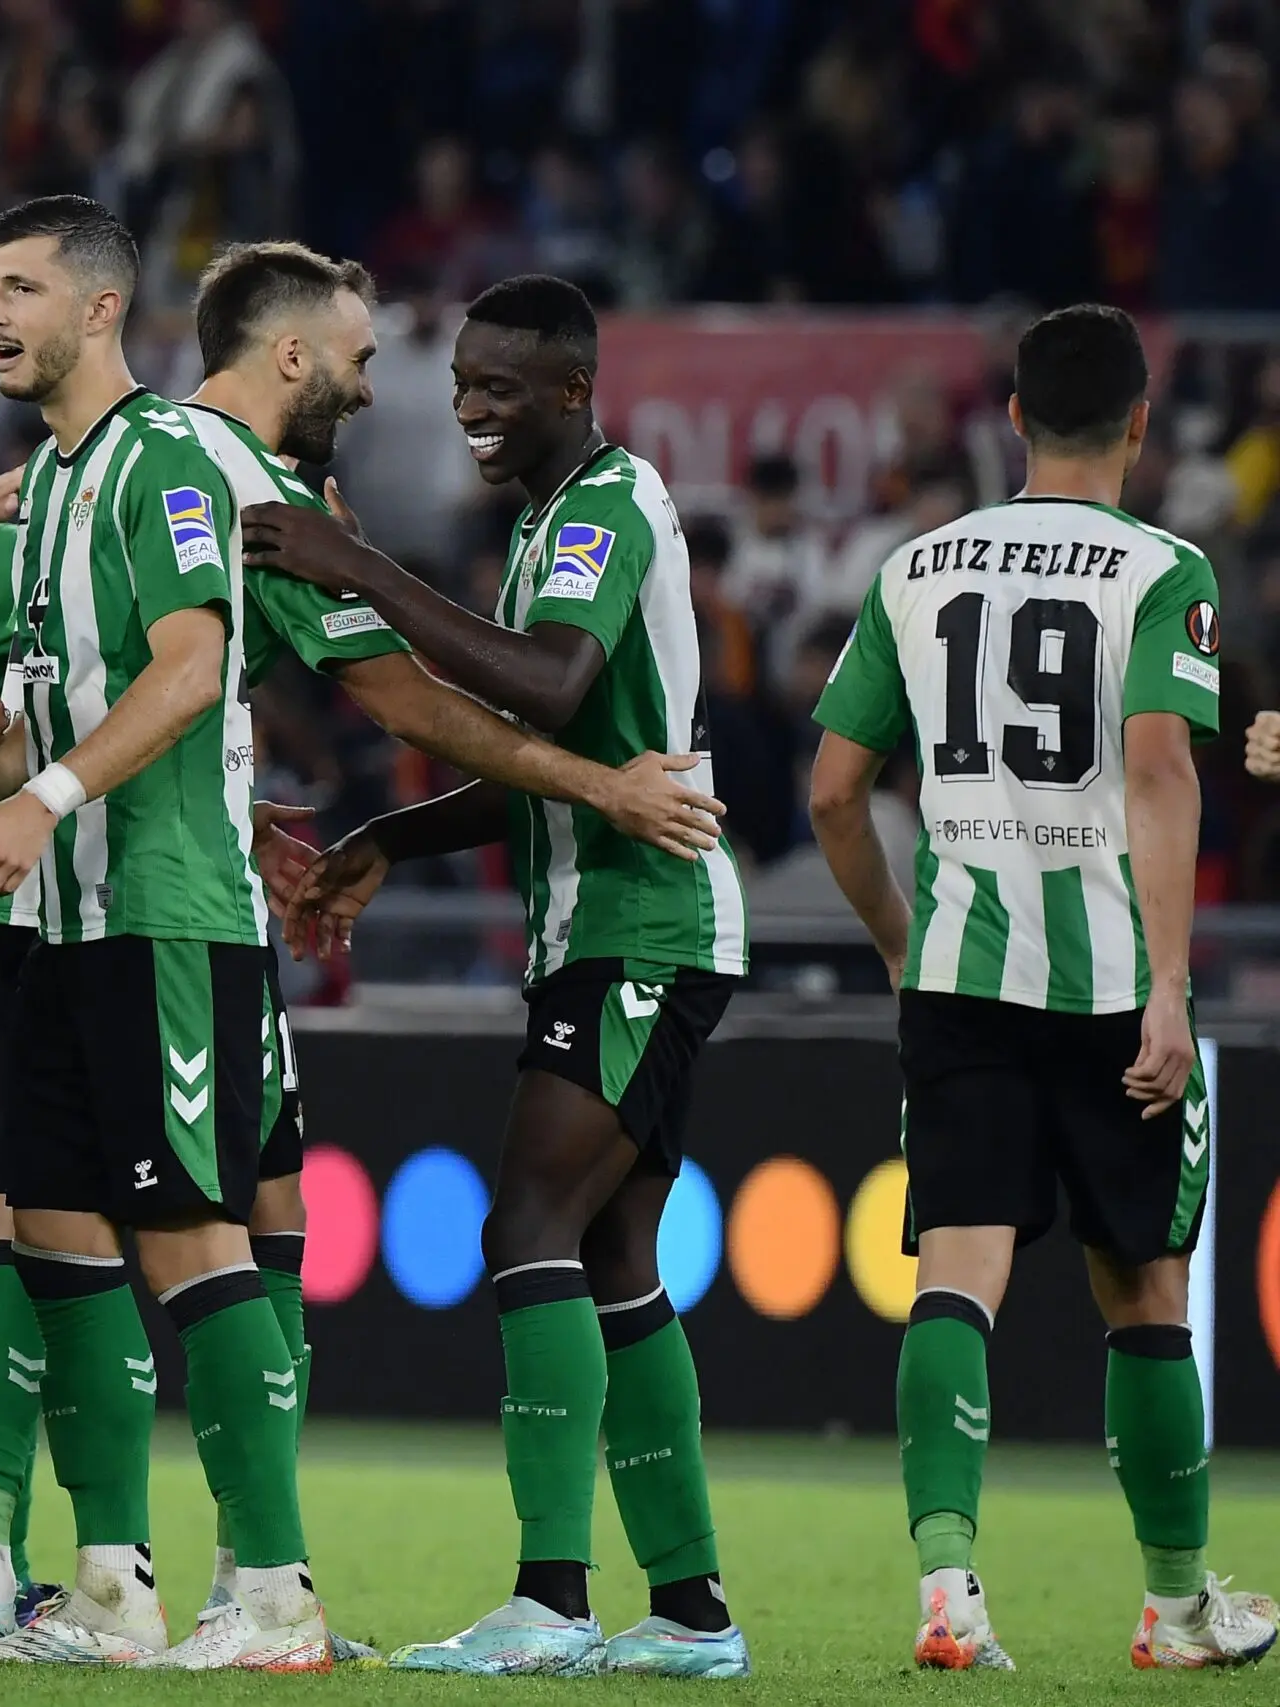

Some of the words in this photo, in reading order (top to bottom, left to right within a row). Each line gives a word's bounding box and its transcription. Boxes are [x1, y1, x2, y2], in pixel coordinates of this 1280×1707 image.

[179, 543, 219, 561] REAL
[907, 538, 989, 581] LUIZ
[998, 542, 1128, 580] FELIPE
[546, 576, 597, 590] REALE
[326, 613, 383, 631] FOUNDAT
[934, 592, 1103, 791] 19
[1035, 825, 1108, 848] GREEN
